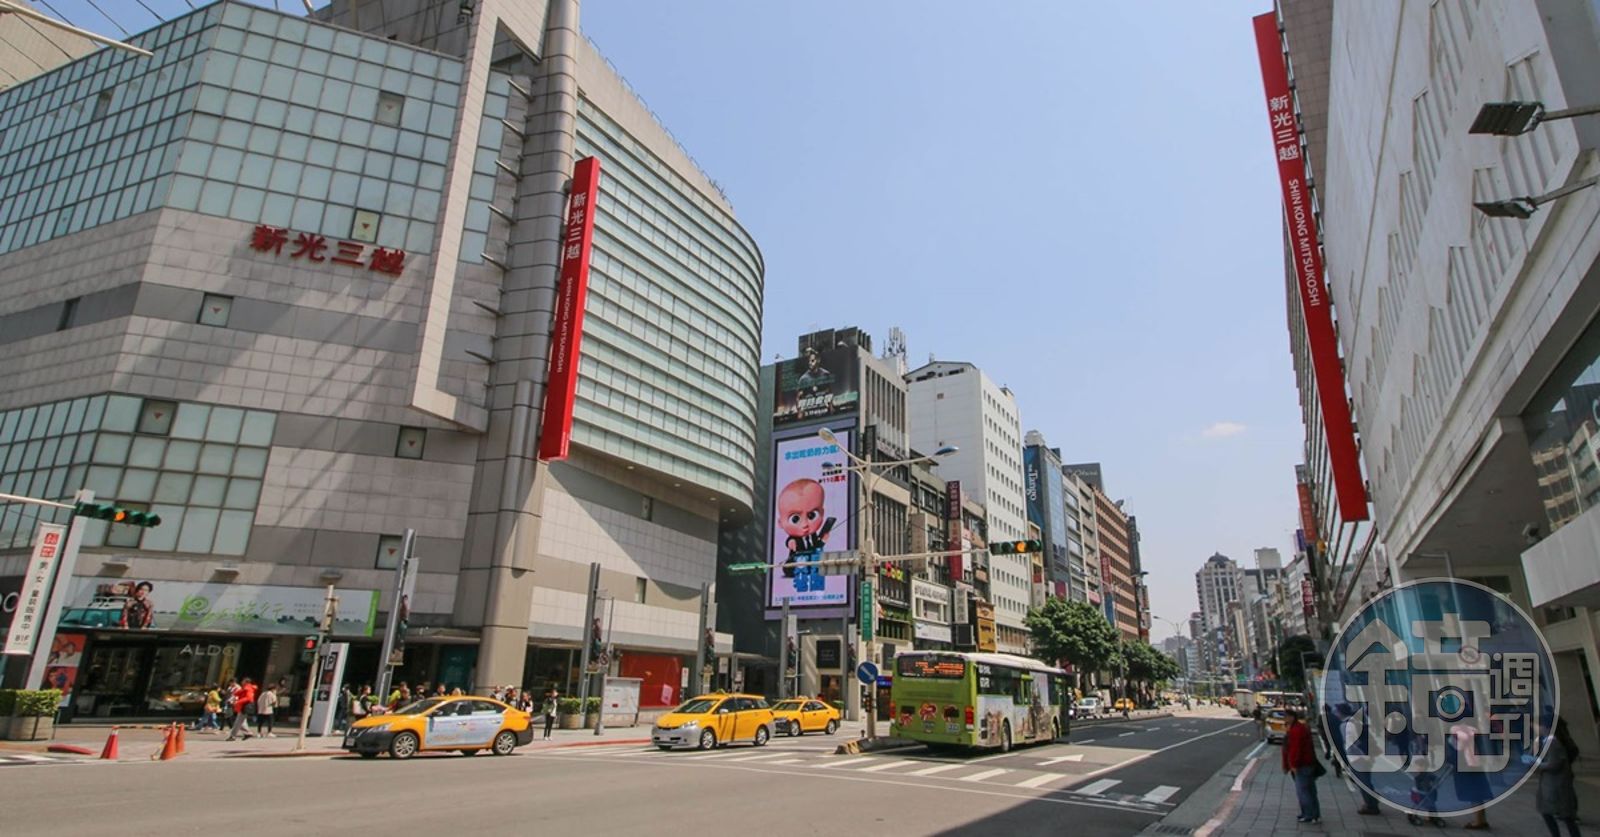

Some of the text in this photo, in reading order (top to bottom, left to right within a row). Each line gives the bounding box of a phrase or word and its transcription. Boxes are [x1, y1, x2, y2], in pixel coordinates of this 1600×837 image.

[1270, 95, 1299, 161] 新光三越
[250, 223, 406, 276] 新光三越
[566, 192, 587, 260] 新光三越
[1288, 179, 1320, 306] SHIN KONG MITSUKOSHI
[1026, 469, 1038, 501] Tango
[180, 644, 236, 657] ALDO
